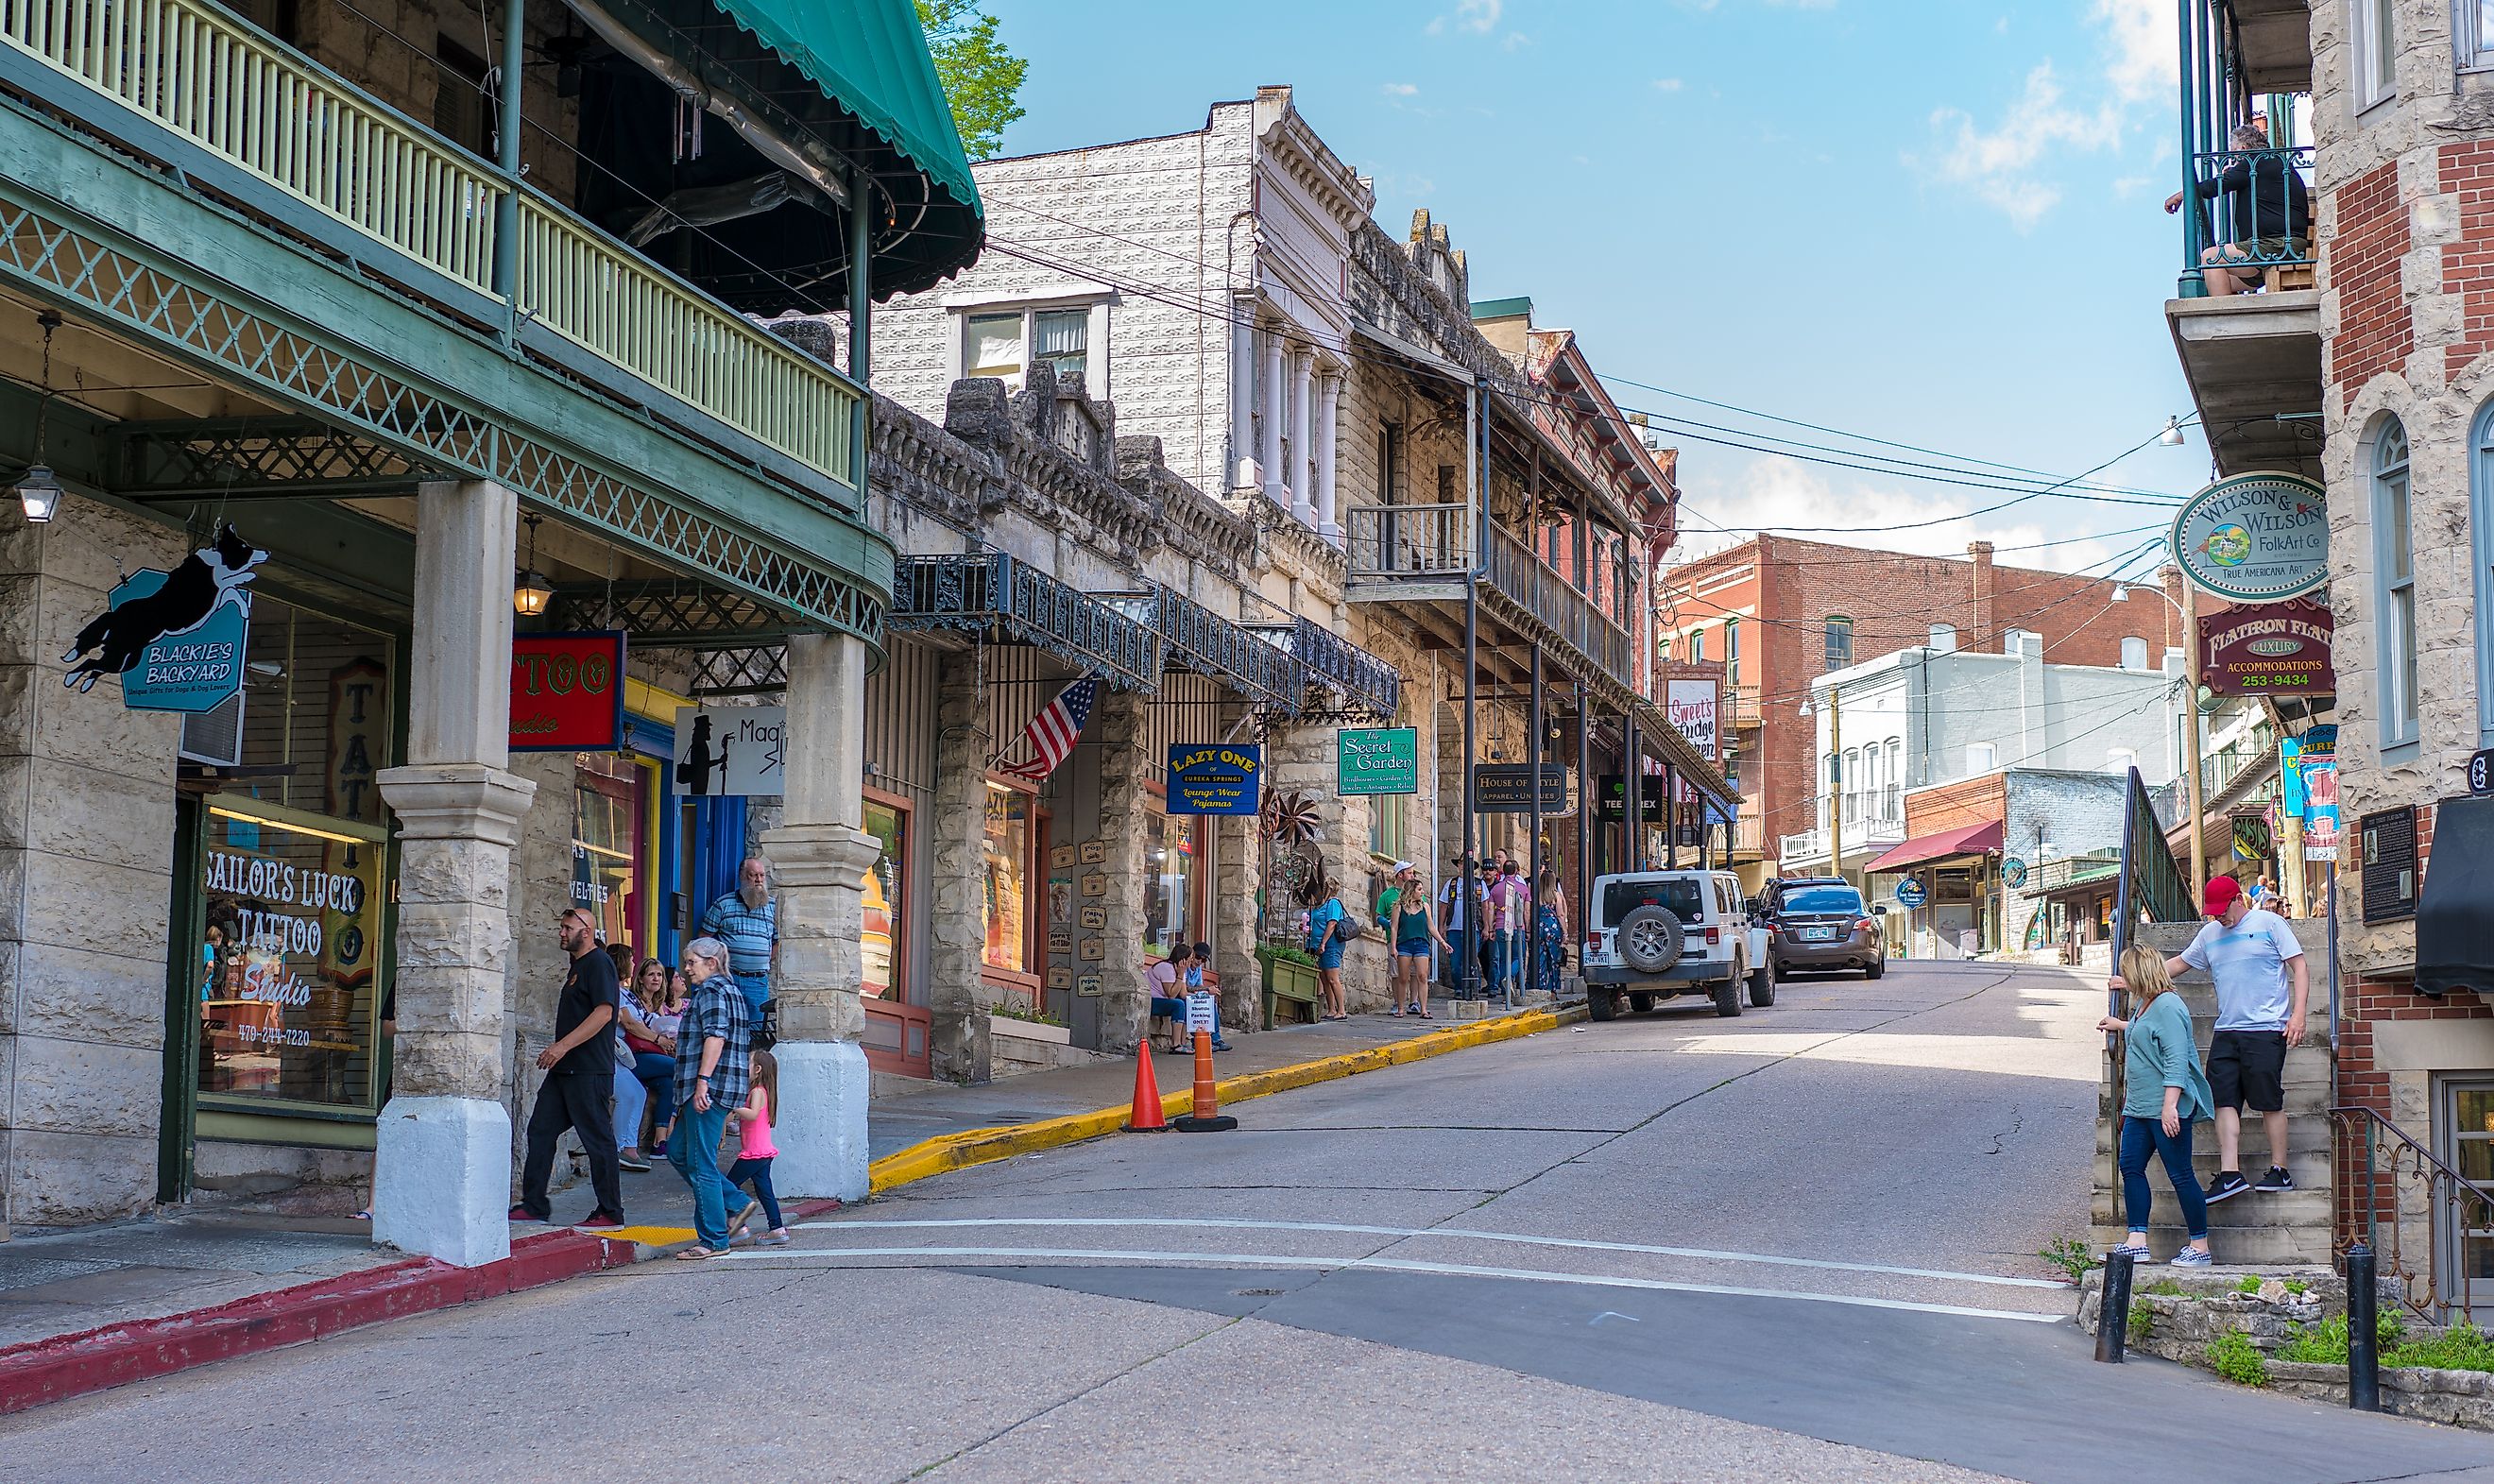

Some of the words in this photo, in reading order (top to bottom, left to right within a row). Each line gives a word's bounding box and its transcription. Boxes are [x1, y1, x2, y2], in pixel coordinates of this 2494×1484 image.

[2197, 489, 2278, 524] WILSON
[2278, 495, 2291, 511] &
[2241, 507, 2323, 534] WILSON
[2259, 536, 2304, 552] FolkArt
[2222, 569, 2242, 579] TRUE
[2244, 567, 2285, 578] AMERICANA
[2288, 565, 2303, 575] ART
[148, 642, 233, 664] BLACKIE'S
[2207, 619, 2287, 669] FLATIRON
[2252, 640, 2298, 653] LUXURY
[145, 663, 231, 684] BACKYARD
[513, 653, 611, 695] TOO
[2227, 660, 2323, 674] ACCOMMODATIONS
[197, 685, 209, 693] Dog
[2242, 674, 2309, 687] 253-9434
[1671, 697, 1713, 724] Sweet's
[1343, 738, 1392, 755] Secret
[1170, 749, 1217, 773] LAZY
[1220, 750, 1256, 774] ONE
[1357, 754, 1413, 774] Garden
[1379, 774, 1401, 782] Garden
[1479, 777, 1512, 788] HOUSE
[1515, 778, 1528, 787] OF
[1539, 778, 1560, 787] TYLE
[1182, 788, 1215, 798] Lounge
[1216, 788, 1242, 797] Wear
[1341, 783, 1361, 792] Jewelry
[1191, 798, 1233, 810] Pajamas
[1605, 800, 1623, 809] TEE
[301, 868, 356, 913] LUCK
[238, 908, 322, 957] TATTOO
[240, 963, 312, 1006] Studio
[238, 1023, 310, 1047] 479-244-7220
